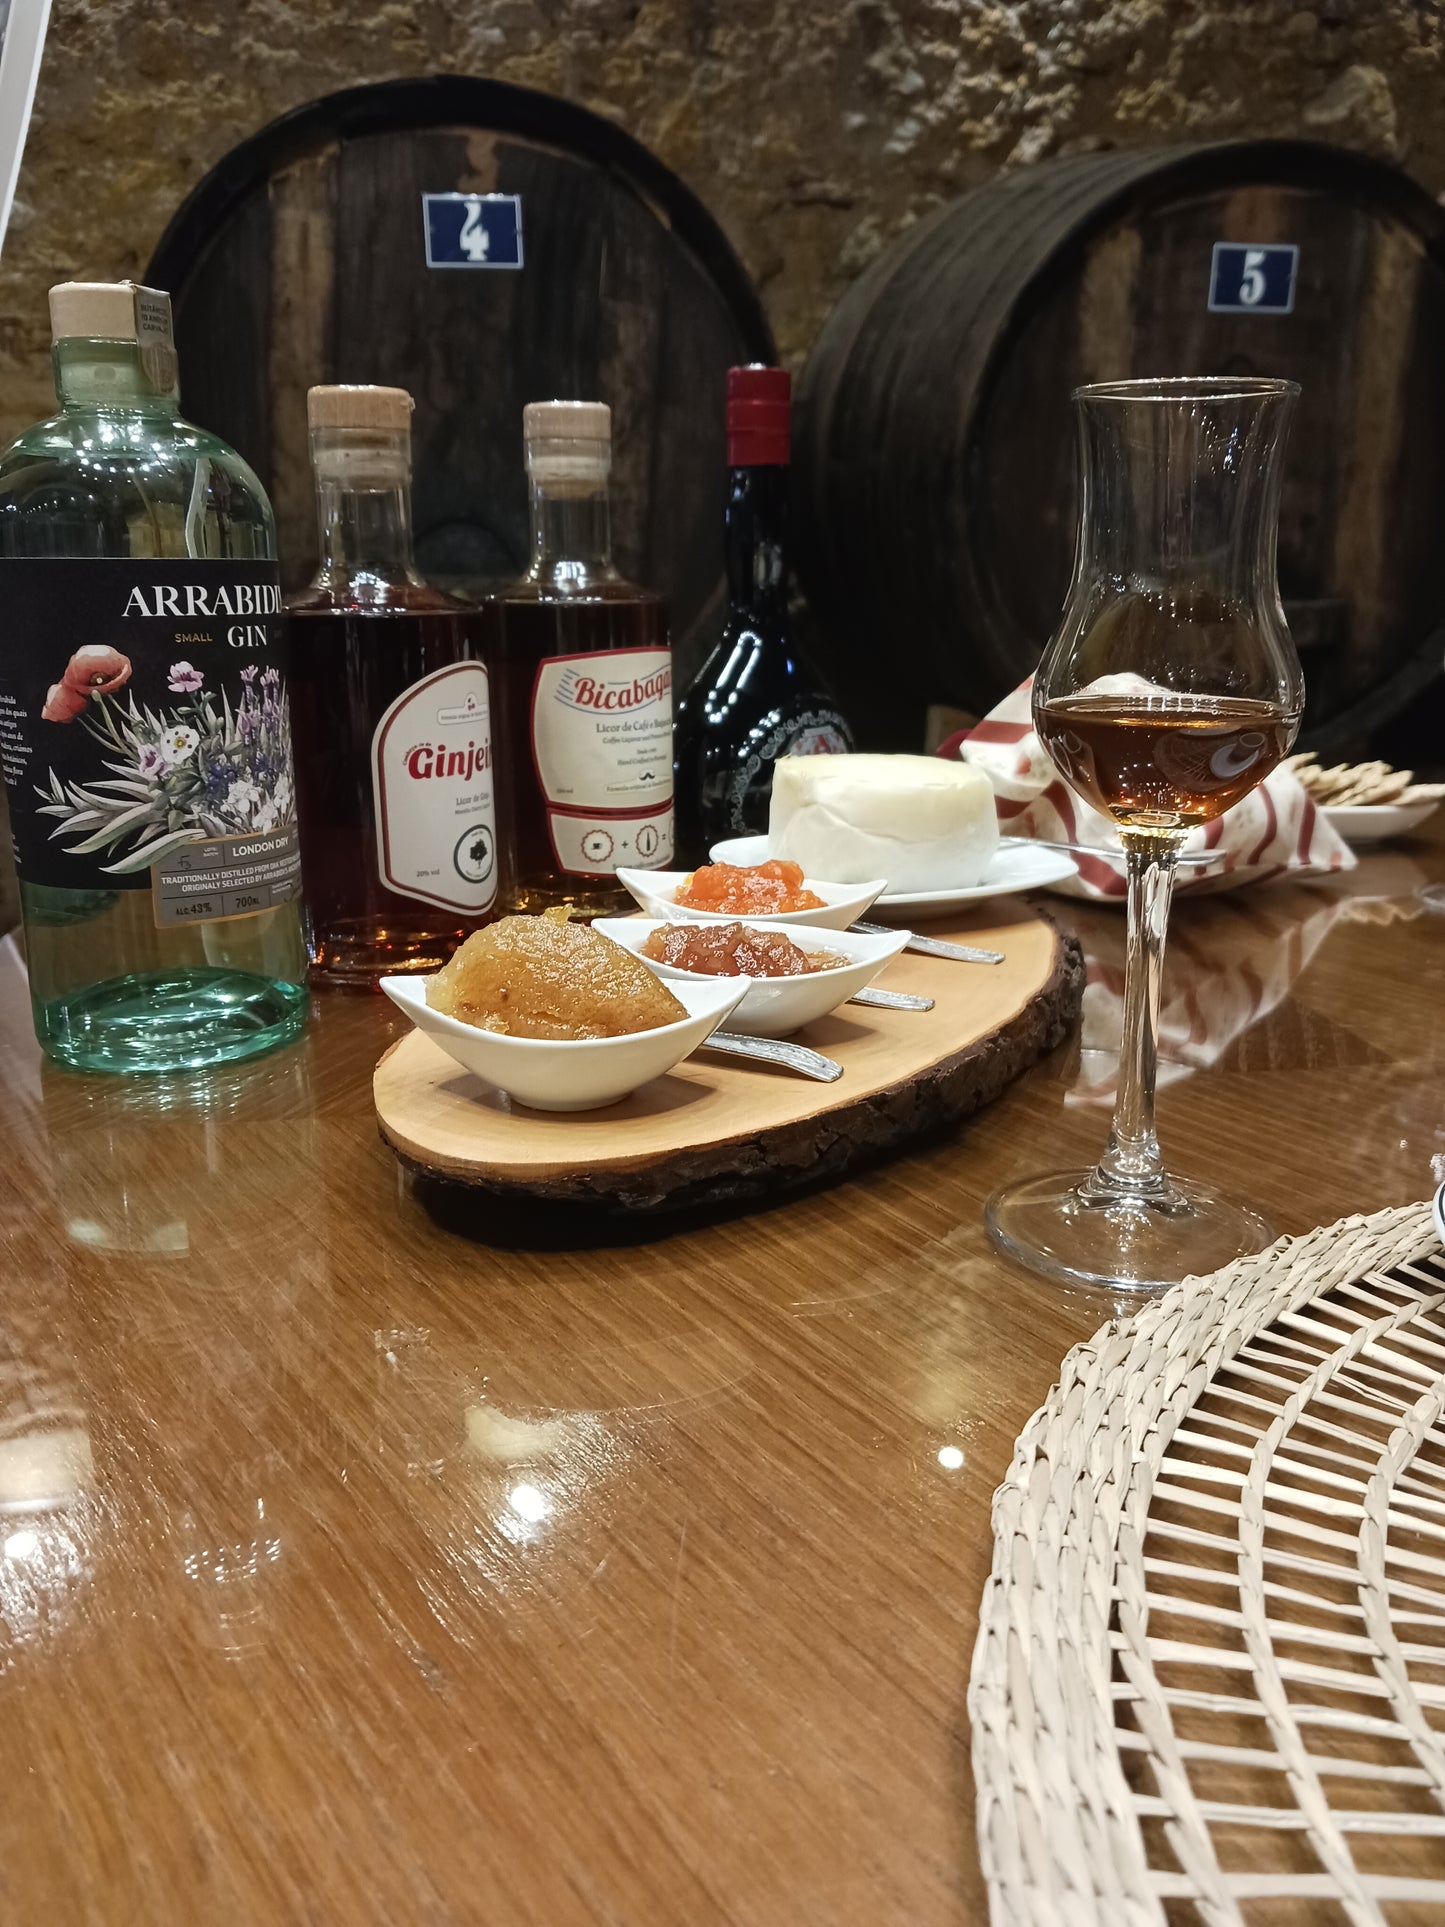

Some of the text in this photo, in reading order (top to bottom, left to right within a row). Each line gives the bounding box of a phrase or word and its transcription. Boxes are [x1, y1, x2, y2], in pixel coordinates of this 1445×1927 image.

[459, 201, 490, 262] 4
[1239, 250, 1266, 305] 5
[174, 625, 267, 648] SMALL GIN
[596, 723, 620, 733] Licor
[621, 721, 632, 731] de
[232, 836, 289, 857] LONDON DRY
[161, 872, 220, 884] TRADITIONALLY
[221, 867, 254, 878] DISTILLED
[254, 864, 270, 875] FROM
[181, 882, 220, 893] ORIGINALY
[222, 876, 254, 888] SELECTED
[255, 874, 262, 882] BY
[190, 902, 212, 914] 43%
